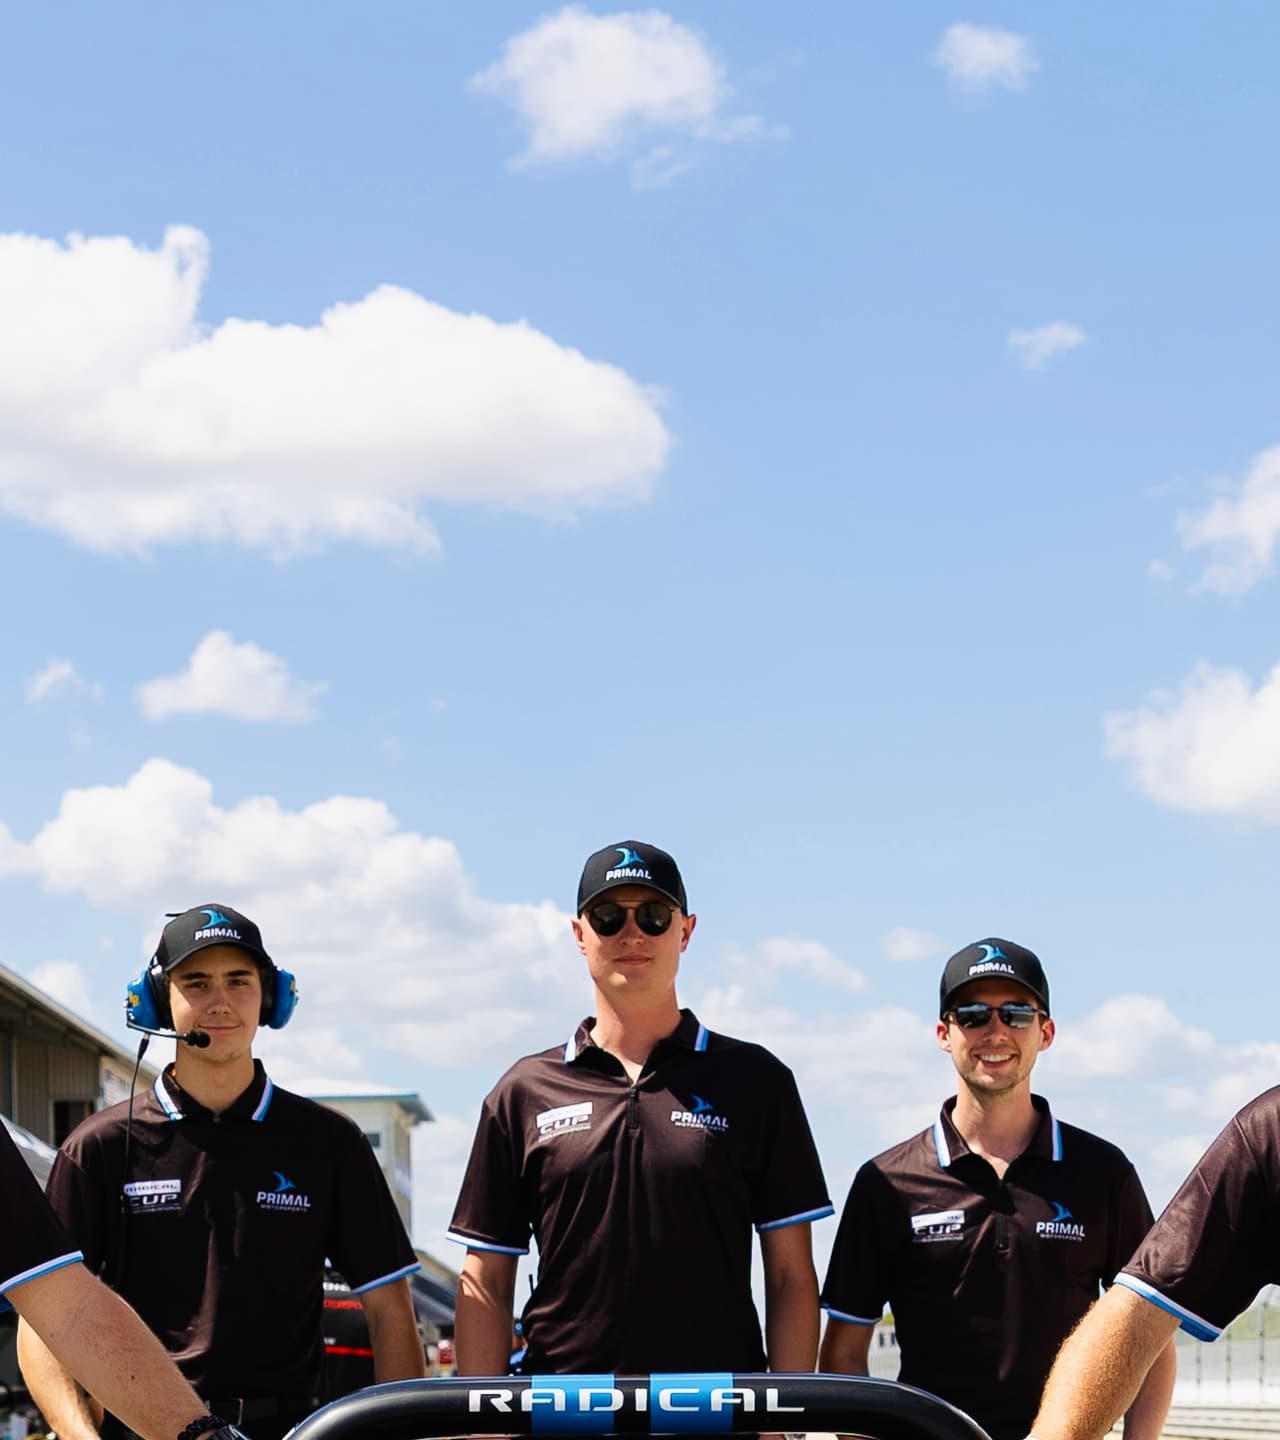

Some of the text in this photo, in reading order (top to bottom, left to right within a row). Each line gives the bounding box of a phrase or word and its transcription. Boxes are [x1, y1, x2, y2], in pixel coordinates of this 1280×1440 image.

[605, 867, 652, 881] PRIMAL
[194, 927, 241, 941] PRIMAL
[969, 962, 1015, 976] PRIMAL
[670, 1110, 729, 1128] PRIMAL
[256, 1191, 311, 1207] PRIMAL
[914, 1223, 961, 1235] CUP
[1036, 1221, 1086, 1237] PRIMAL
[469, 1388, 806, 1412] RADICAL
